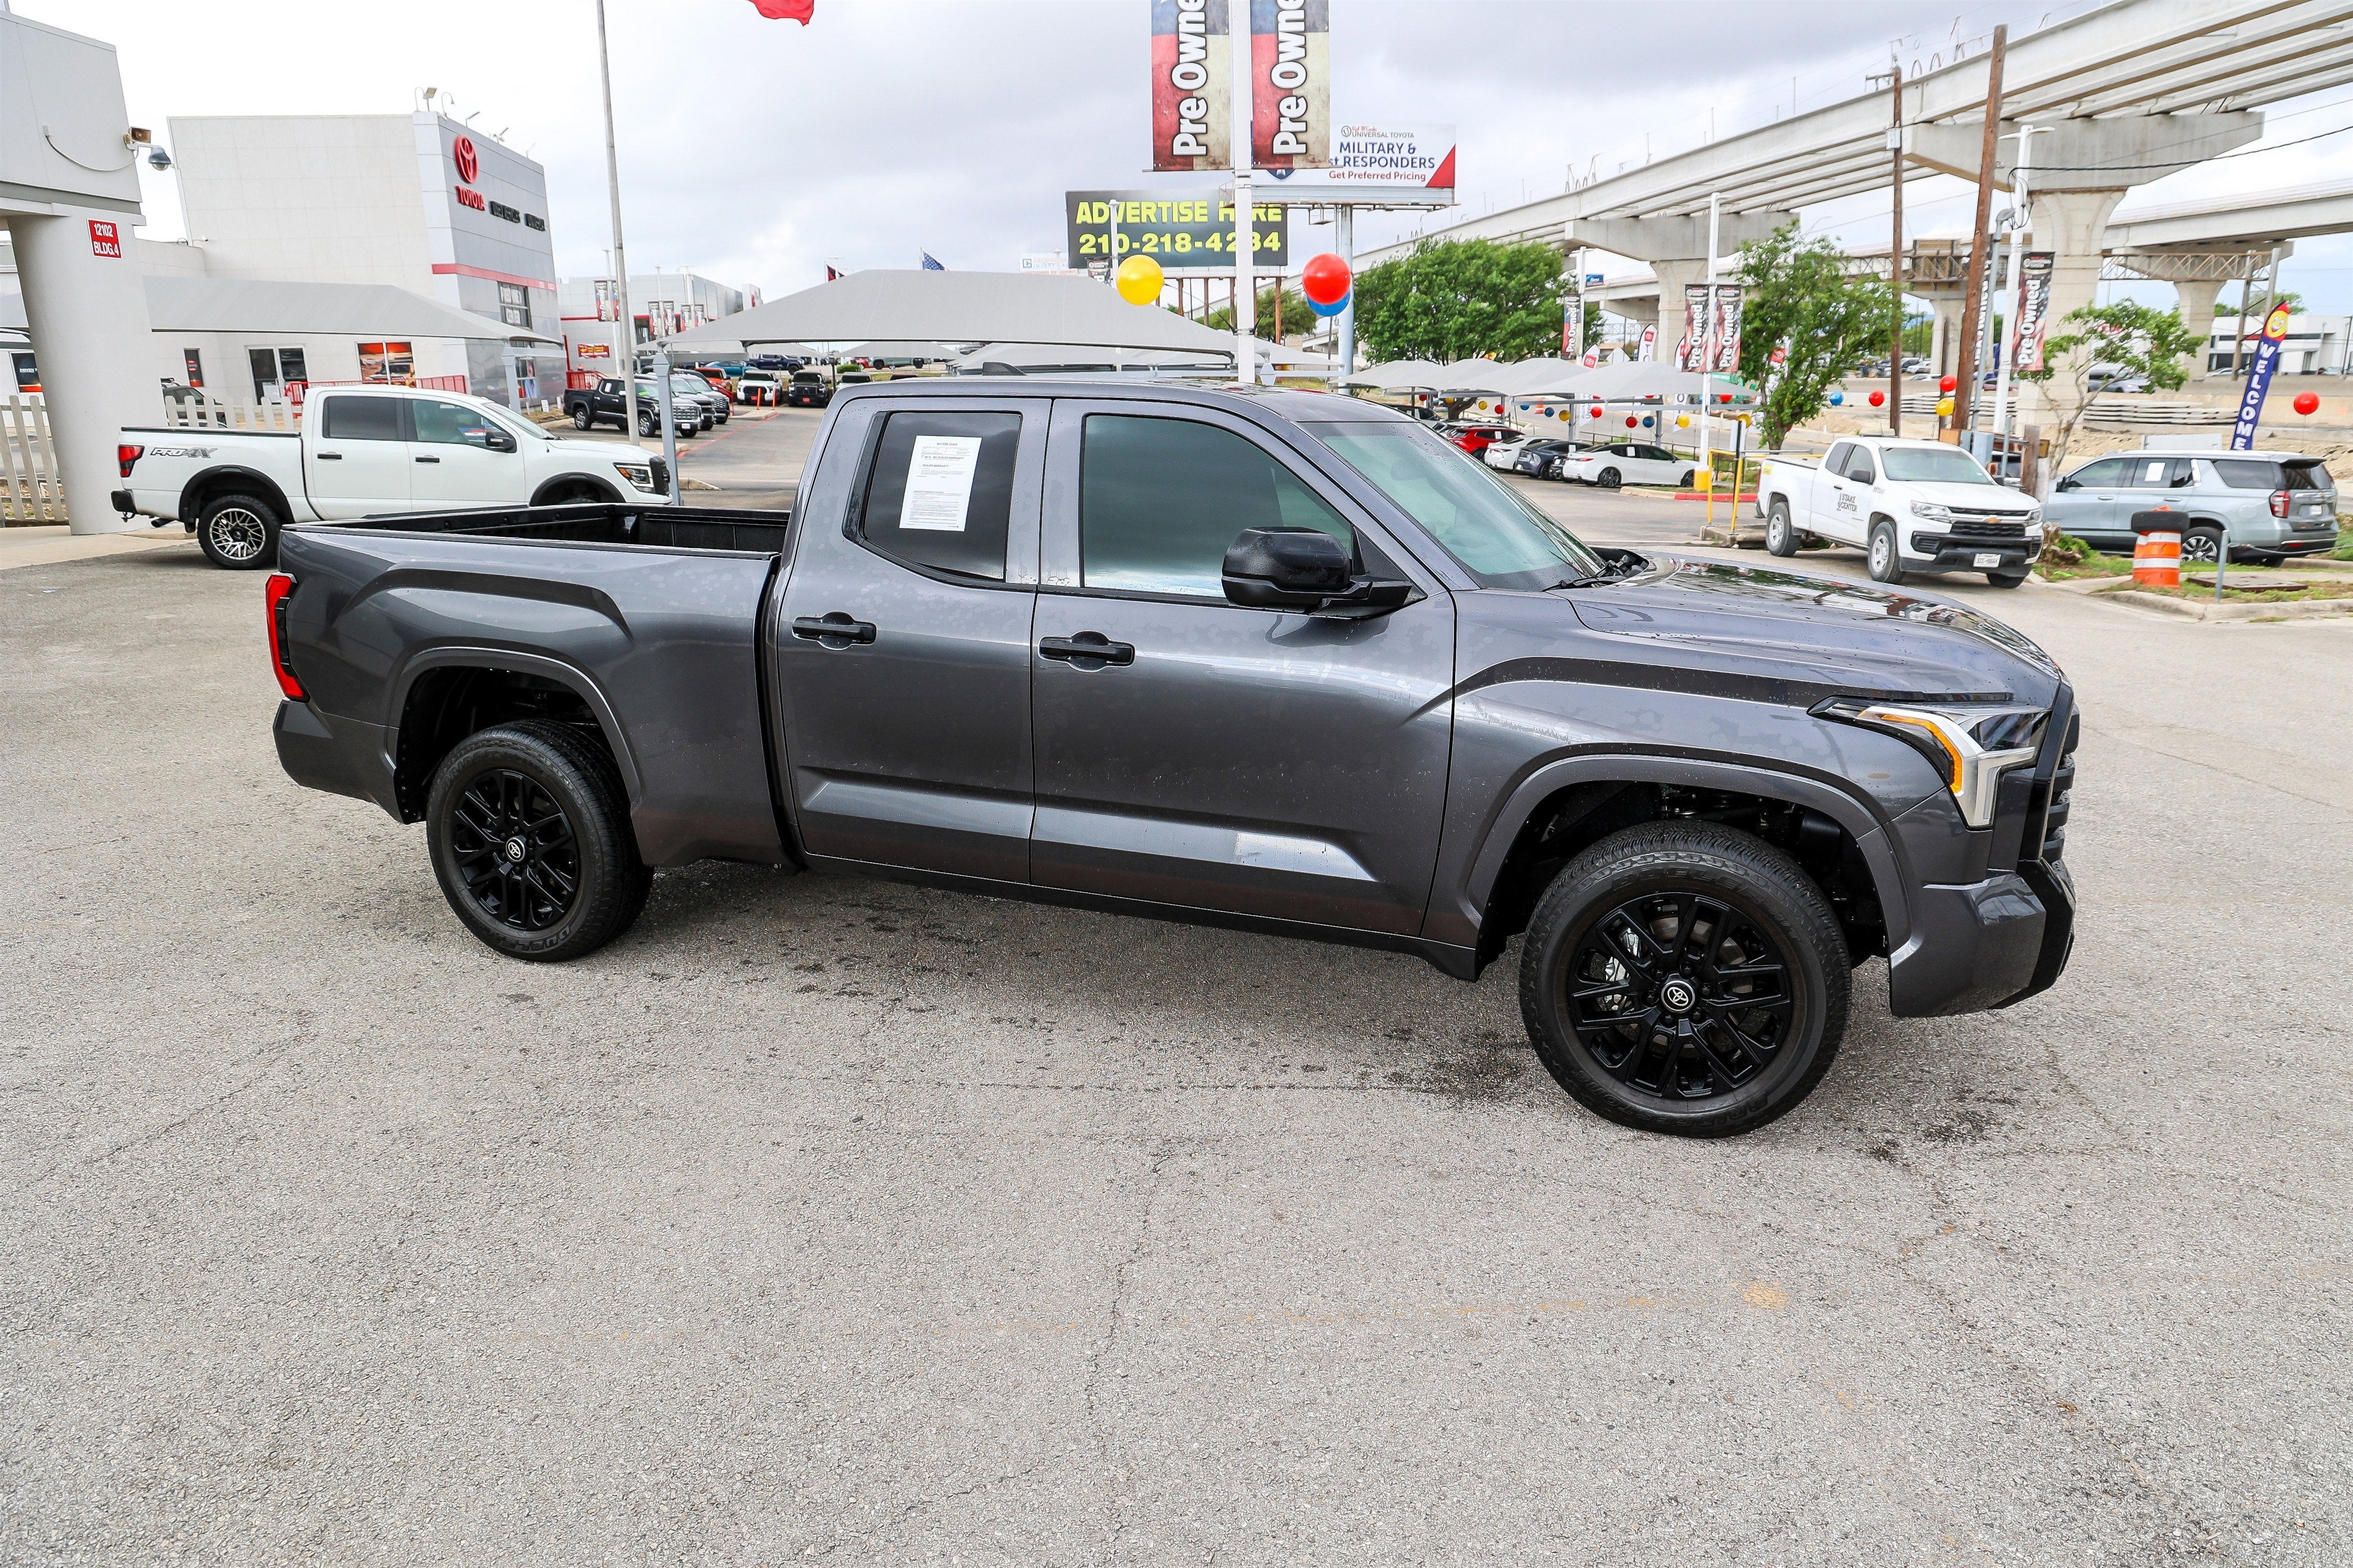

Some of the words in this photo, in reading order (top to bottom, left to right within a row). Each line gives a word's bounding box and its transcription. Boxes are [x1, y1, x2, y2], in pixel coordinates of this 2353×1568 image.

[1171, 0, 1208, 90] Owne
[1172, 97, 1209, 156] Pre
[1272, 95, 1308, 155] Pre
[1340, 141, 1405, 154] MILITARY
[1407, 142, 1417, 155] &
[1343, 155, 1436, 168] RESPONDERS
[1329, 171, 1345, 179] Get
[1348, 171, 1391, 179] Preferred
[1394, 171, 1426, 182] Pricing
[455, 185, 485, 211] TOYOTA
[1076, 201, 1208, 224] ADVERTISE
[1218, 200, 1282, 222] HRE
[94, 223, 114, 238] 12102
[2020, 279, 2040, 335] Owned
[1567, 307, 1577, 337] Owned
[1690, 304, 1703, 346] Owned
[1722, 304, 1734, 346] Owned
[1565, 337, 1576, 353] Pre
[1688, 347, 1702, 368] Pre
[1718, 347, 1733, 368] Pre
[2017, 337, 2034, 365] Pre
[2233, 341, 2276, 450] WELCOME
[1841, 501, 1858, 512] CENTER
[1842, 493, 1856, 503] STAKE
[1610, 865, 1766, 905] DUELER
